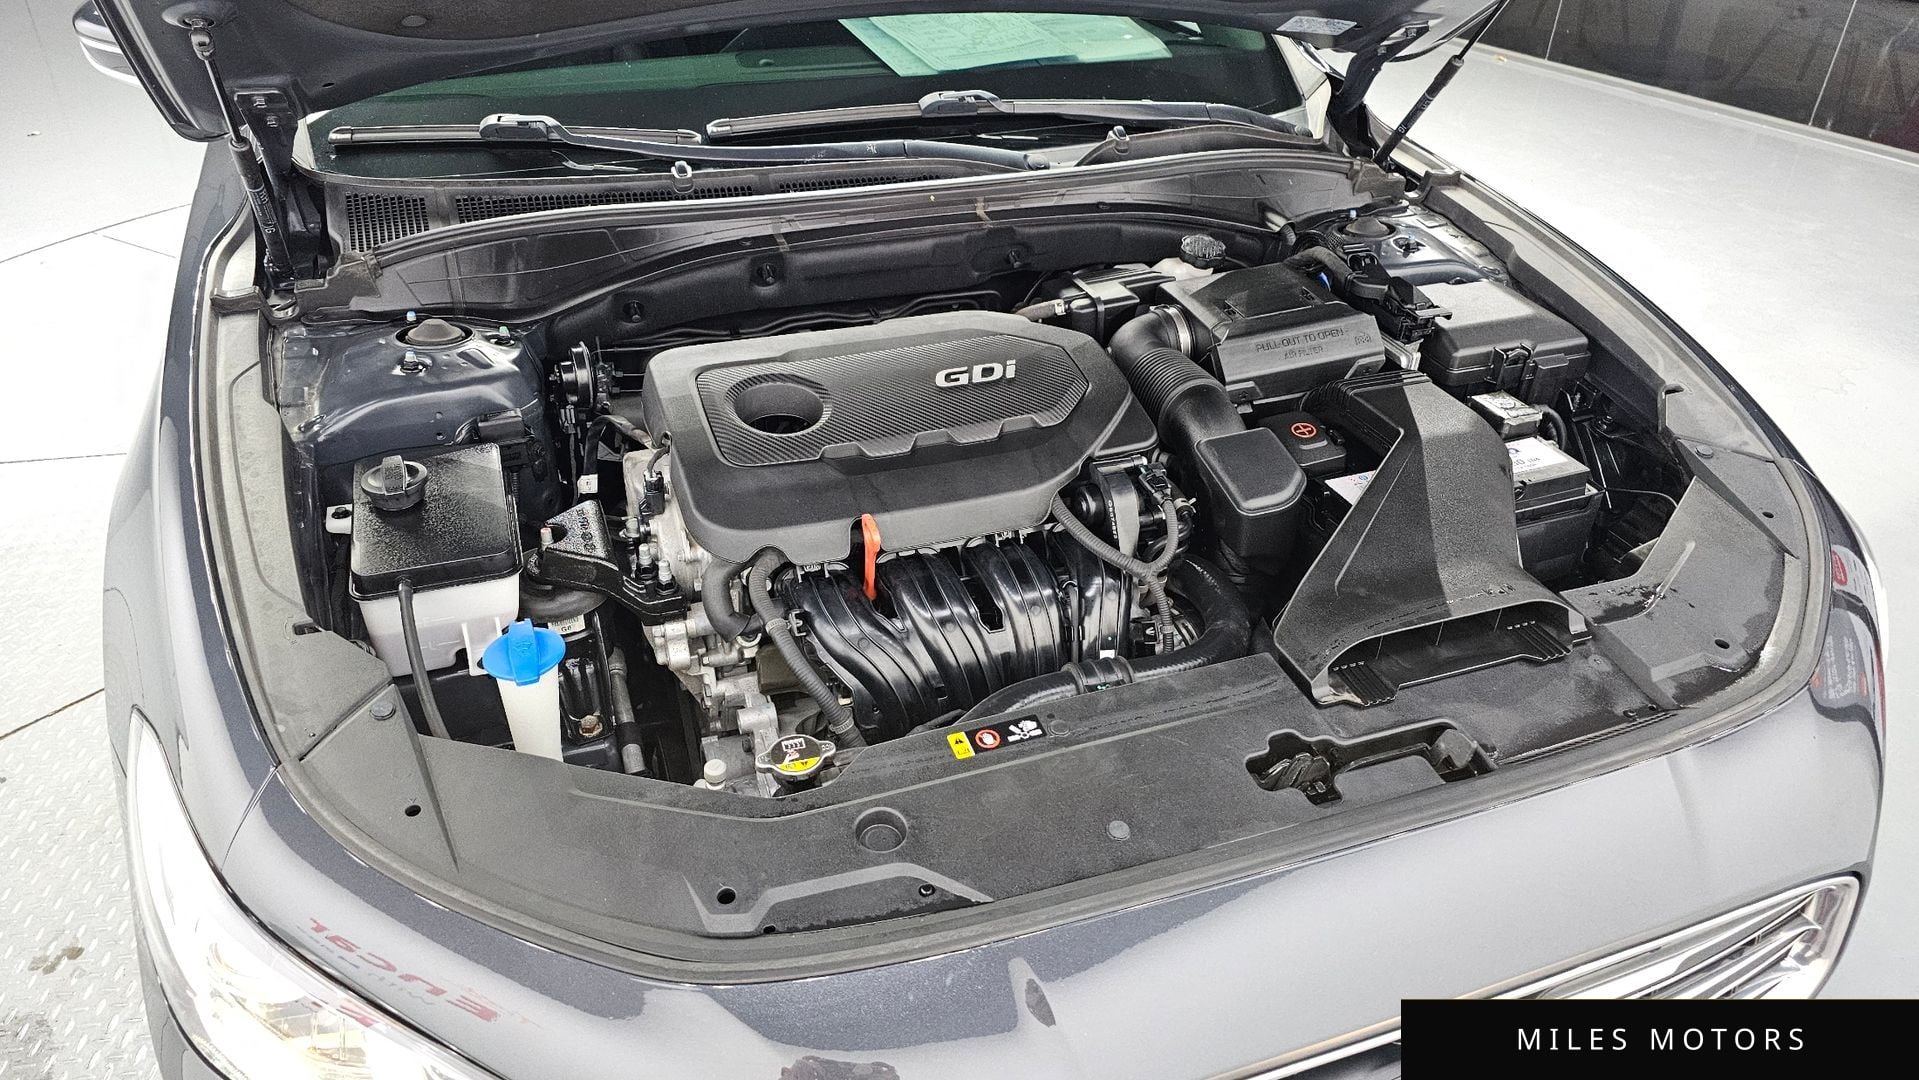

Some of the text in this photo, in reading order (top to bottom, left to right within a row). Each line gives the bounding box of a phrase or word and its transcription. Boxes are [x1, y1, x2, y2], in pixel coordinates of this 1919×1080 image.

[1255, 340, 1281, 353] PULL
[1281, 336, 1301, 347] OUT
[1303, 333, 1317, 343] TO
[1318, 328, 1345, 341] OPEN
[935, 359, 1016, 387] GDi
